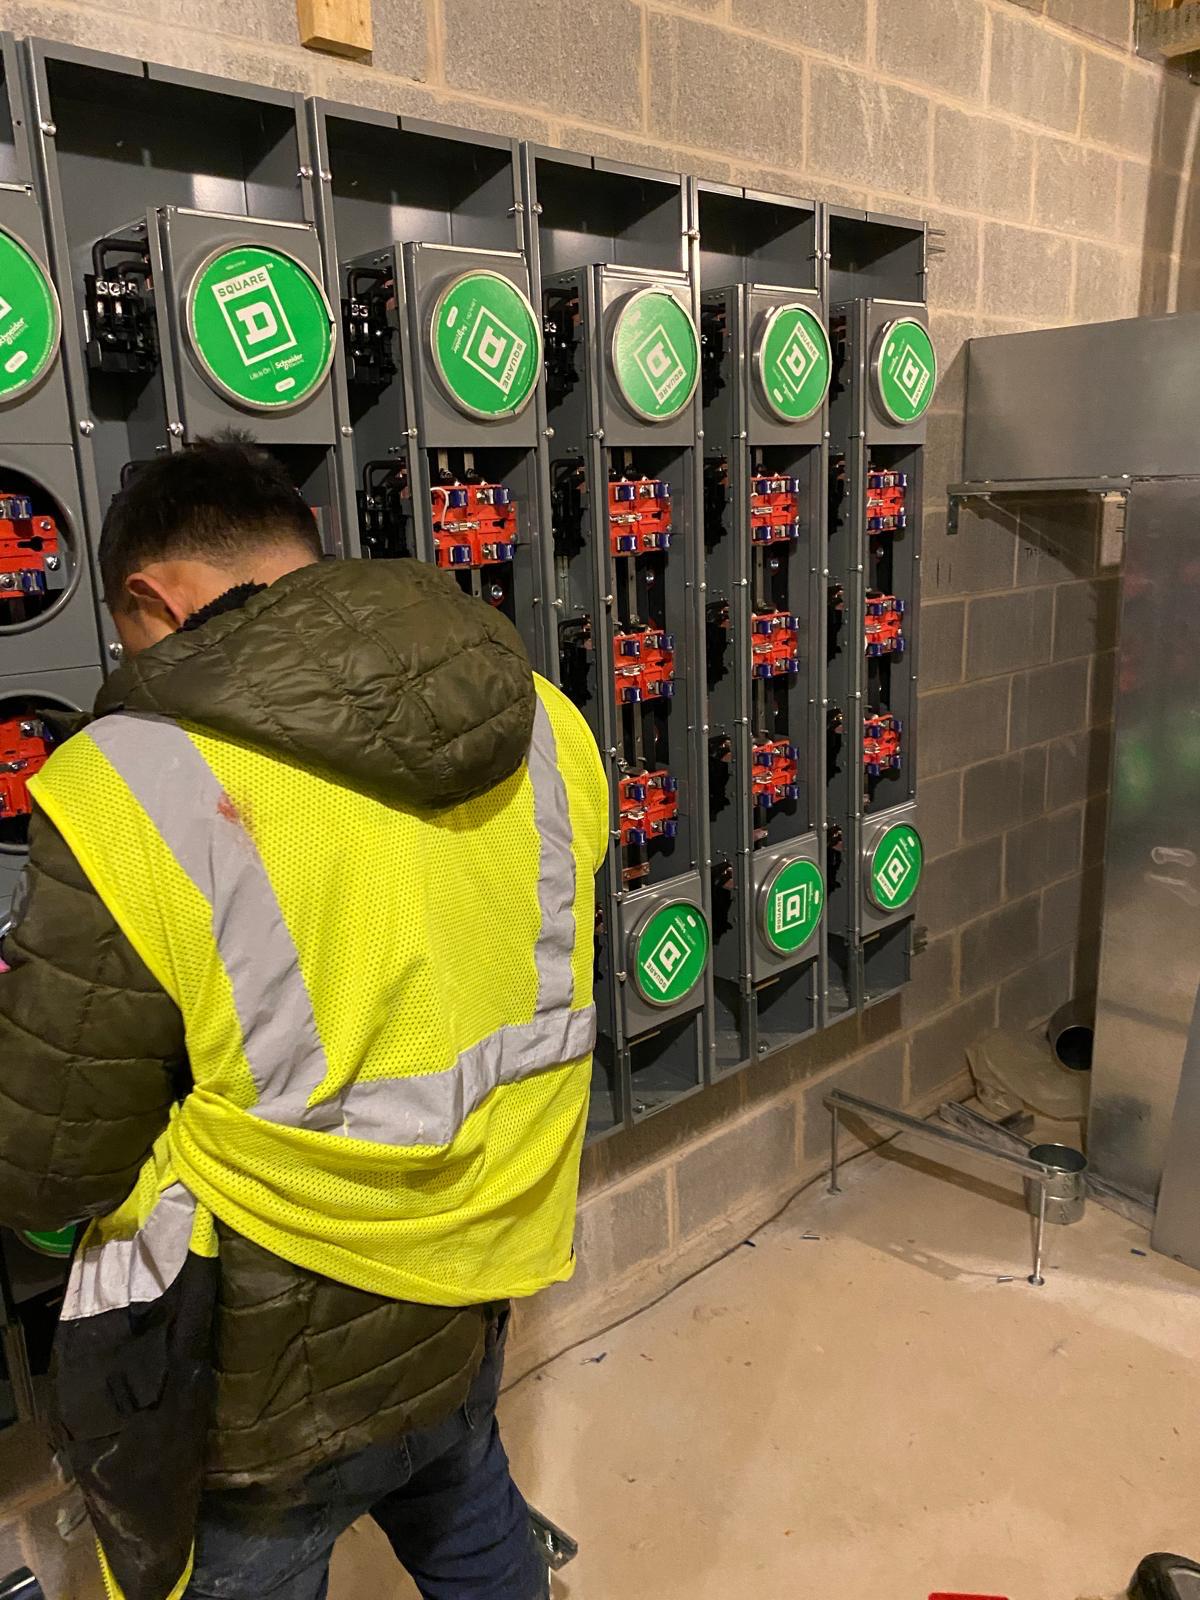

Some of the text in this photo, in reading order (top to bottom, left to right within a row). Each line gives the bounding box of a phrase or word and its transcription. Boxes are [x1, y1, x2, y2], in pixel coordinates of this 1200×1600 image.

[217, 272, 266, 297] SQUARE
[234, 301, 279, 346] D
[275, 353, 303, 371] Schneider
[478, 325, 507, 369] D
[646, 340, 672, 378] D
[785, 343, 806, 377] D
[502, 342, 523, 390] SQUARE
[902, 357, 920, 389] D
[657, 368, 684, 400] SQUARE
[888, 857, 905, 884] D
[786, 894, 801, 922] D
[658, 940, 682, 973] D
[646, 961, 667, 989] SQUARE
